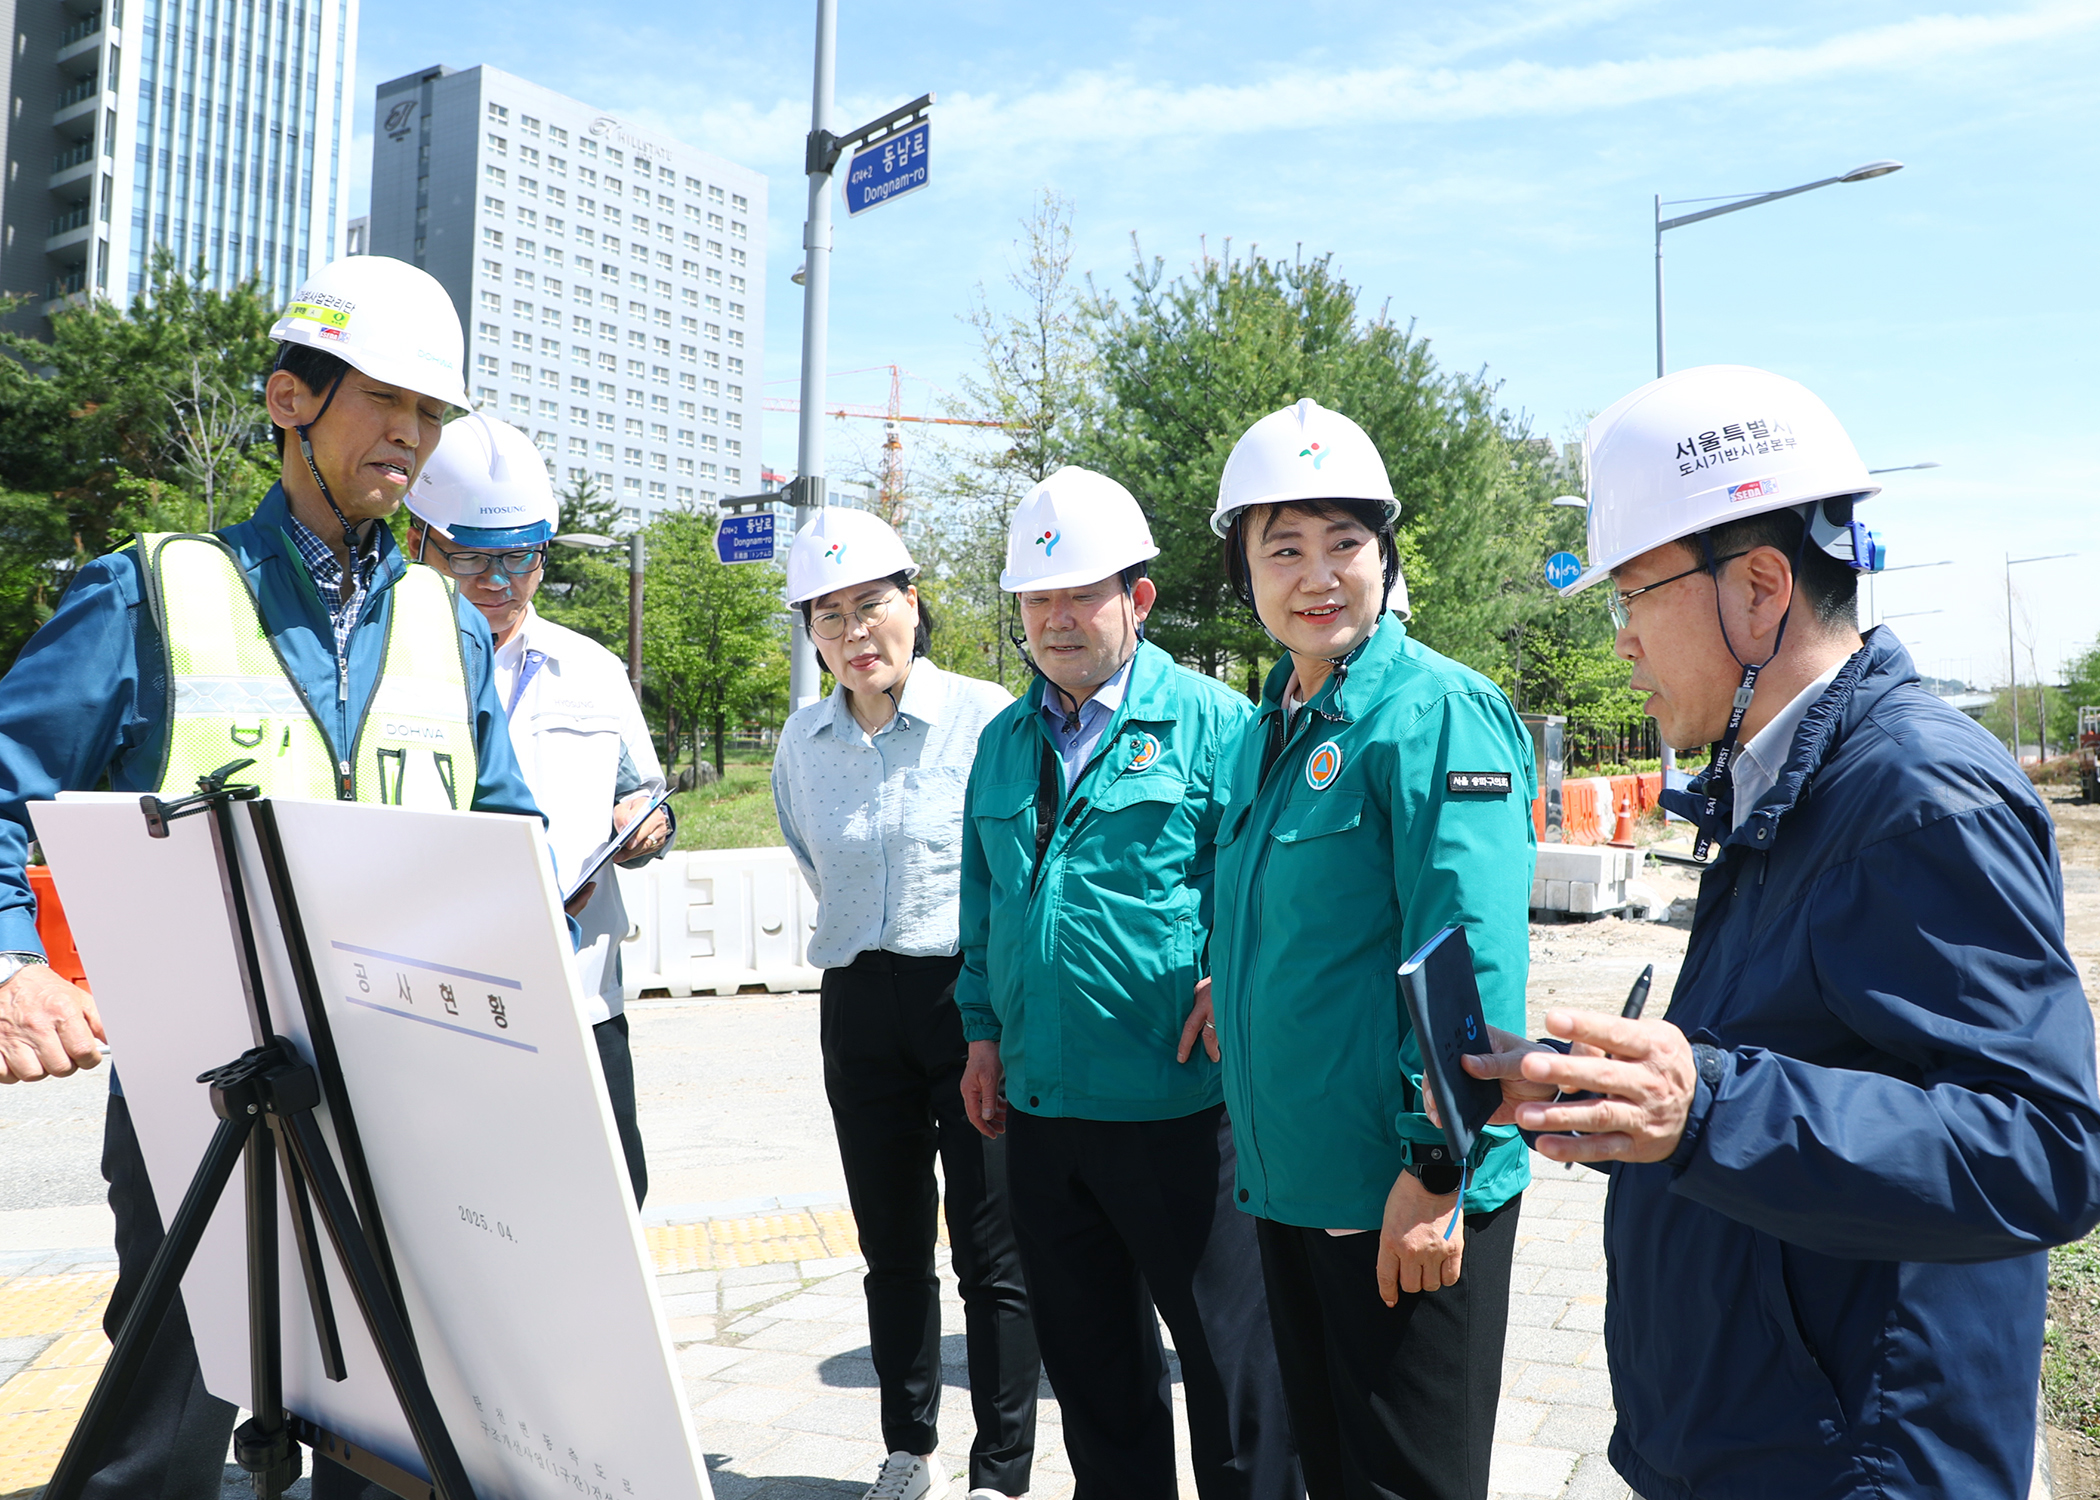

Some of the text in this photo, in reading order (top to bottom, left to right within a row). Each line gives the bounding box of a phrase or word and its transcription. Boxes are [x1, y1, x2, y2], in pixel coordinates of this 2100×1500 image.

[883, 132, 925, 173] 동남로
[864, 167, 925, 203] Dongnam-ro
[417, 349, 454, 370] DOHWA
[1675, 418, 1793, 460] 서울특별시
[1678, 437, 1798, 477] 도시기반시설본부
[1729, 487, 1762, 503] SSEDA
[480, 505, 526, 515] HYOSUNG
[746, 517, 773, 534] 동남로
[733, 536, 773, 548] Dongnam-ro
[386, 723, 445, 740] DOHWA
[1453, 775, 1509, 788] 서울 송파구의회
